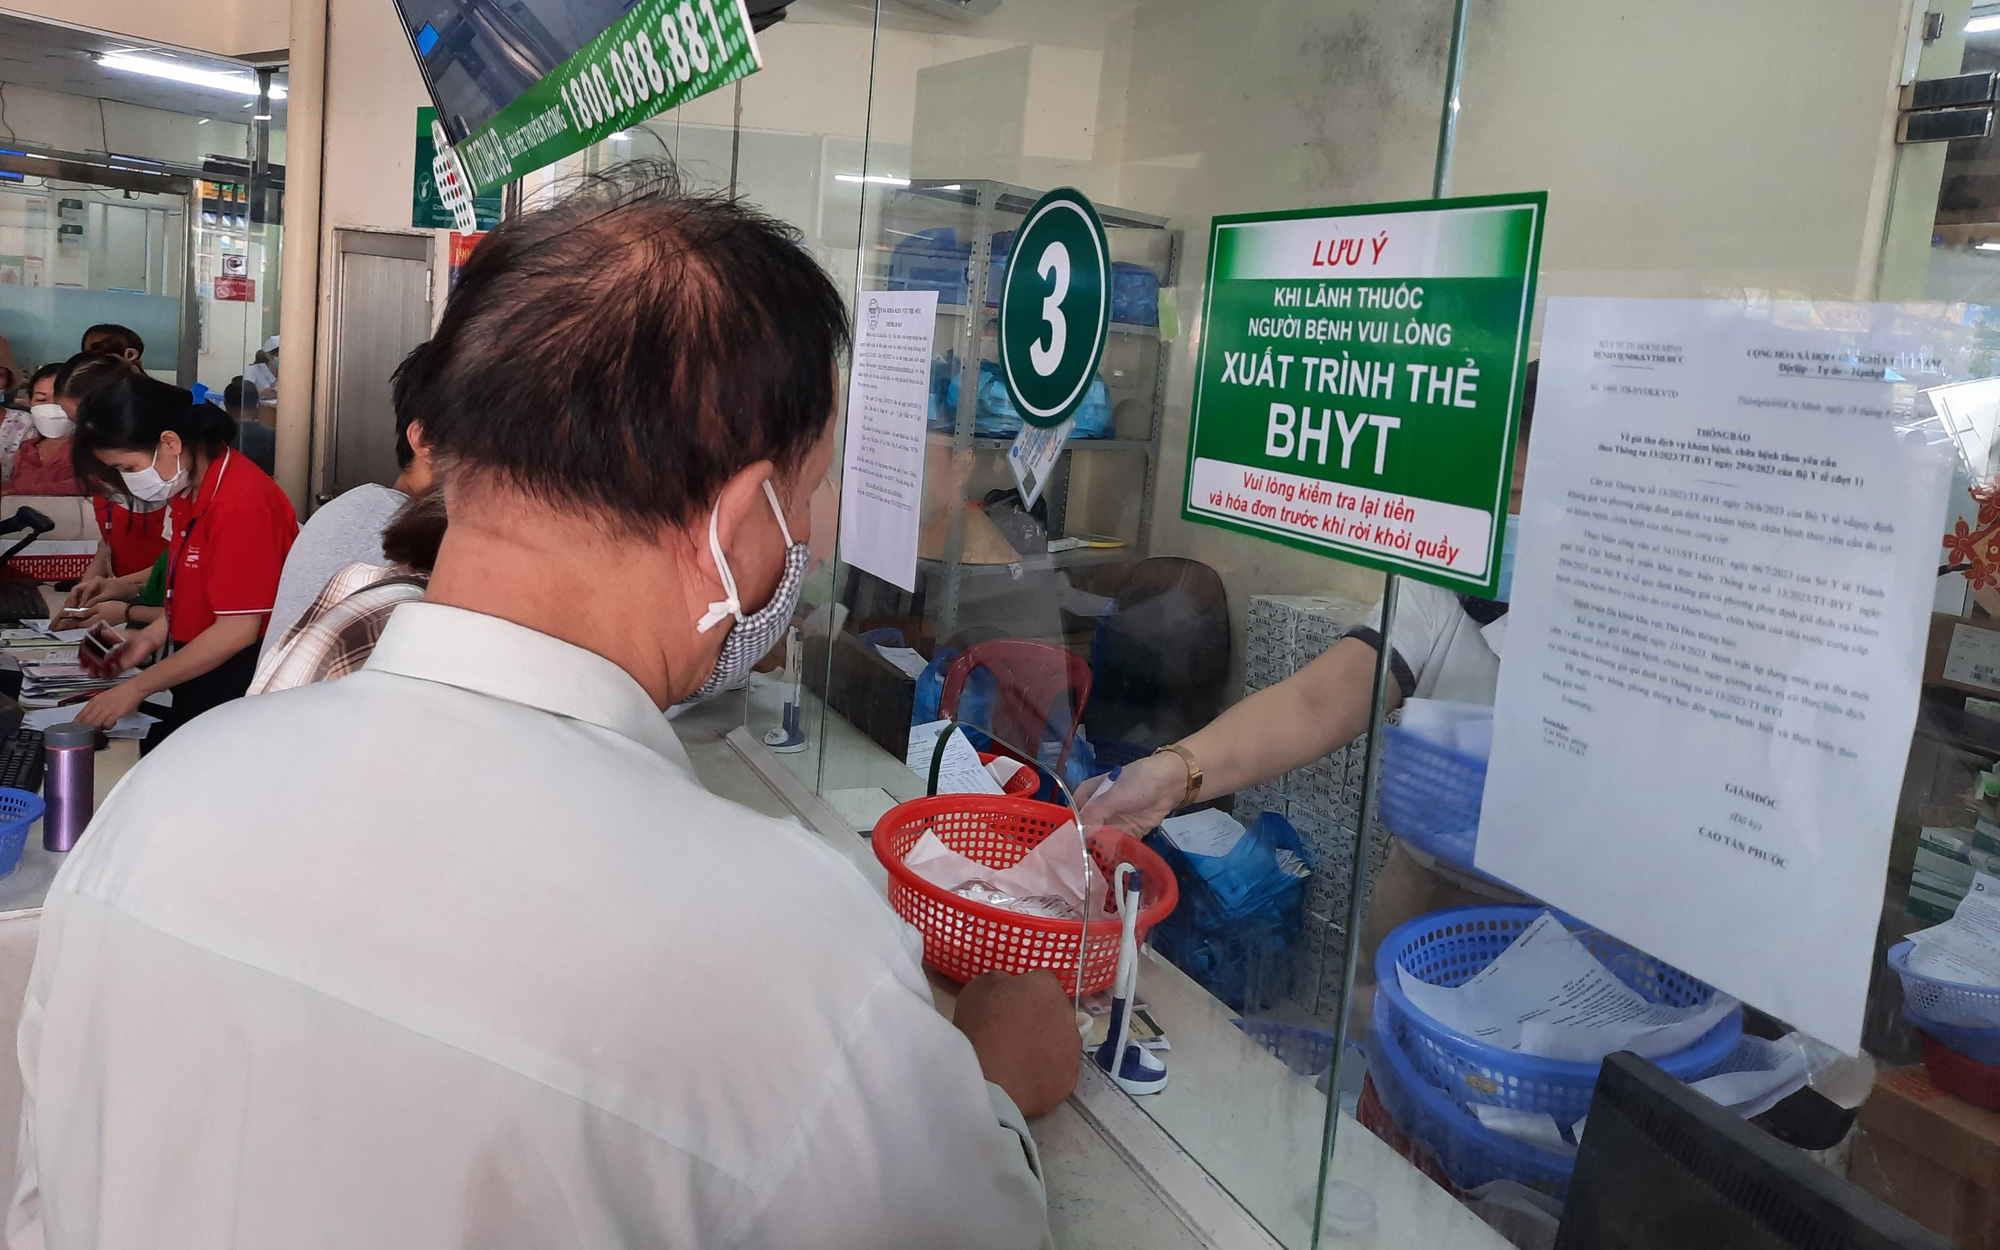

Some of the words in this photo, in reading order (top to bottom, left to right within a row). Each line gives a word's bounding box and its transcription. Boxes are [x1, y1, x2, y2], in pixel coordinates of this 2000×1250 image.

[1312, 238, 1365, 267] LƯU
[1372, 230, 1388, 265] Ý
[1029, 241, 1071, 377] 3
[1274, 287, 1302, 307] KHI
[1305, 283, 1352, 308] LÃNH
[1357, 283, 1424, 310] THUỐC
[1248, 314, 1301, 338] NGƯỜI
[1304, 319, 1353, 345] BỆNH
[1358, 321, 1389, 343] VUI
[1392, 317, 1452, 346] LÒNG
[1220, 346, 1295, 389] XUẤT
[1301, 350, 1395, 400] TRÌNH
[1406, 358, 1480, 408] THẺ
[1265, 402, 1401, 475] BHYT
[1243, 473, 1264, 491] Vui
[1265, 478, 1297, 503] lòng
[1298, 483, 1333, 505] kiểm
[1336, 492, 1357, 512] tra
[1359, 495, 1381, 517] lại
[1383, 497, 1416, 522] tiền
[1209, 493, 1224, 506] và
[1225, 493, 1249, 513] hóa
[1250, 498, 1278, 519] đơn
[1279, 506, 1319, 529] trước
[1321, 515, 1346, 535] khi
[1347, 524, 1372, 541] rời
[1374, 527, 1412, 550] khỏi
[1415, 537, 1460, 566] quầy
